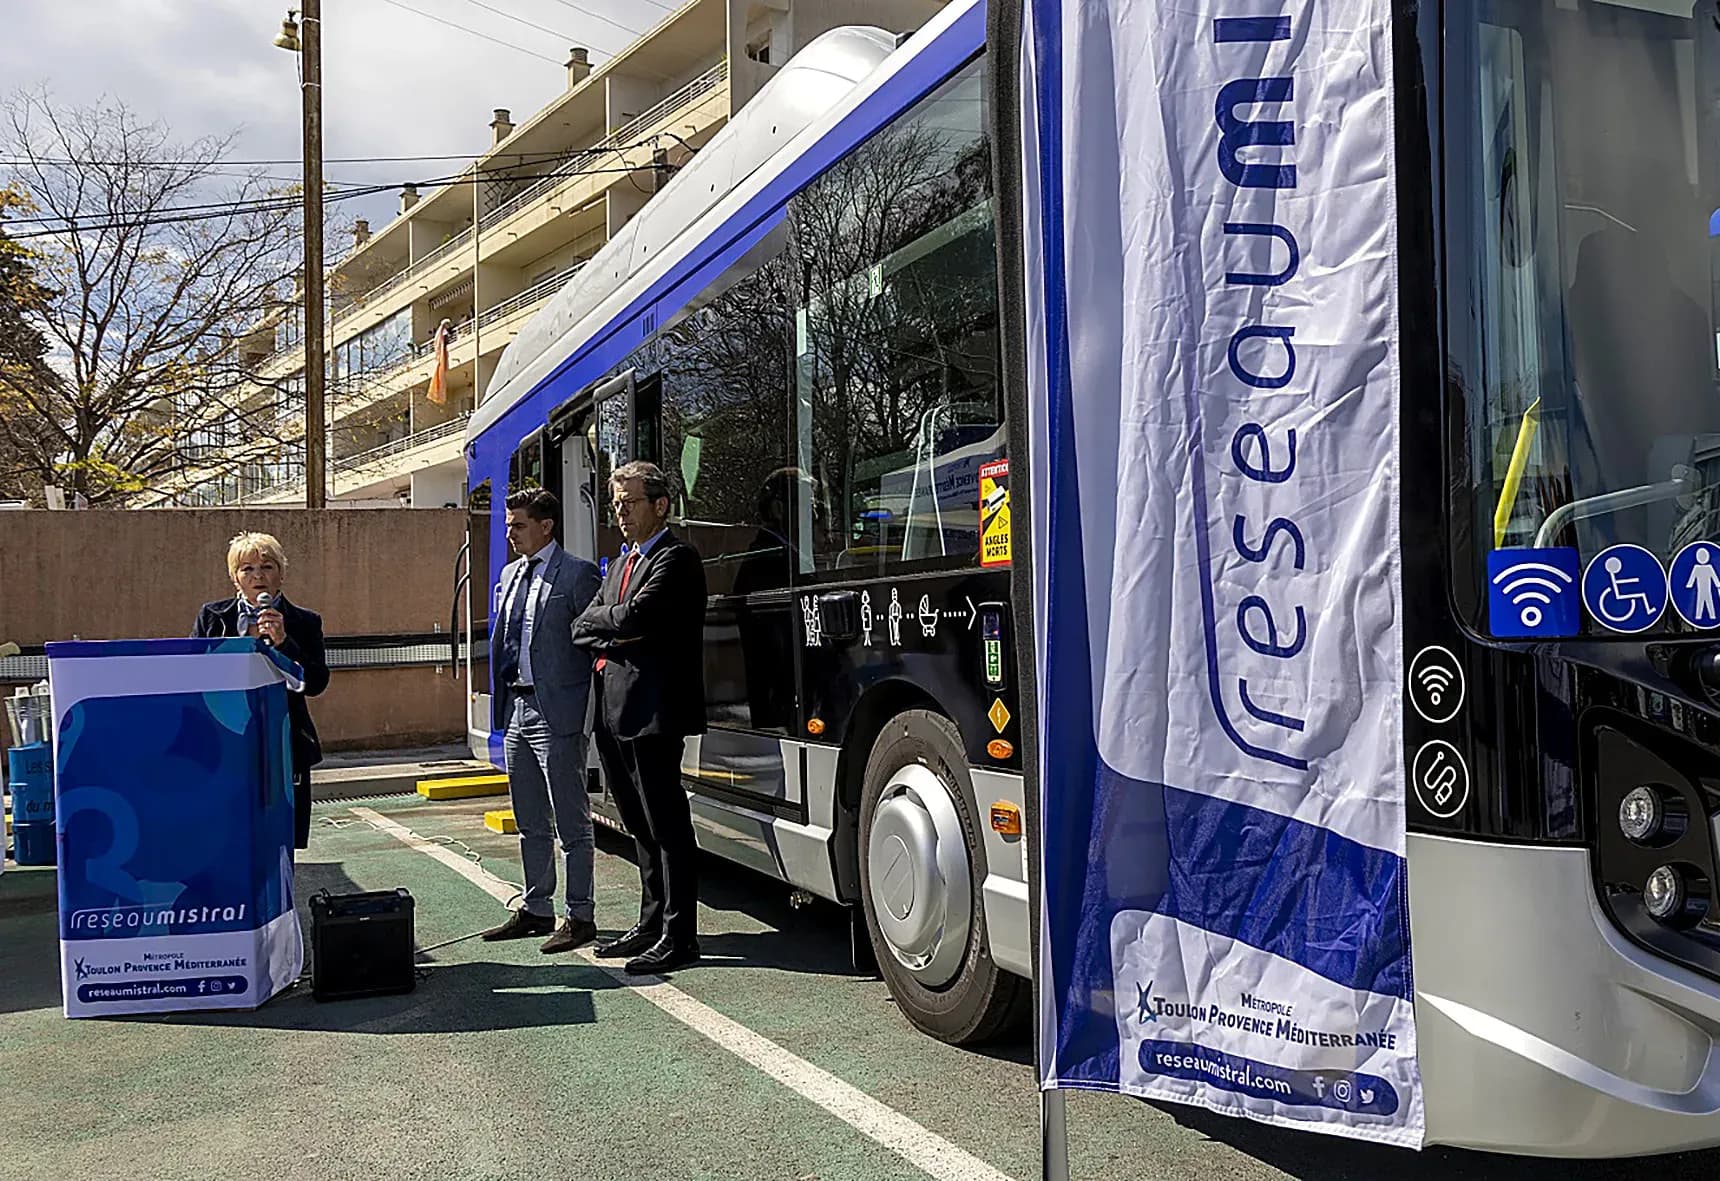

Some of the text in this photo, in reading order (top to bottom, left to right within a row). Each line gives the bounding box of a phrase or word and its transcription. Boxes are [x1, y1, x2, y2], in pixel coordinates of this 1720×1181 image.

[981, 463, 1009, 477] ATTENTIO
[985, 534, 1008, 546] ANGLES
[986, 546, 1008, 558] MORTS
[70, 903, 246, 929] reseaumistral
[86, 957, 247, 976] TOULON PROVENCE MÉDITERRANÉE
[88, 983, 187, 998] reseaumistral.com
[1153, 996, 1397, 1051] TOULON PROVENCE MÉDITERRANÉE
[1156, 1051, 1291, 1095] reseaumistral.com
